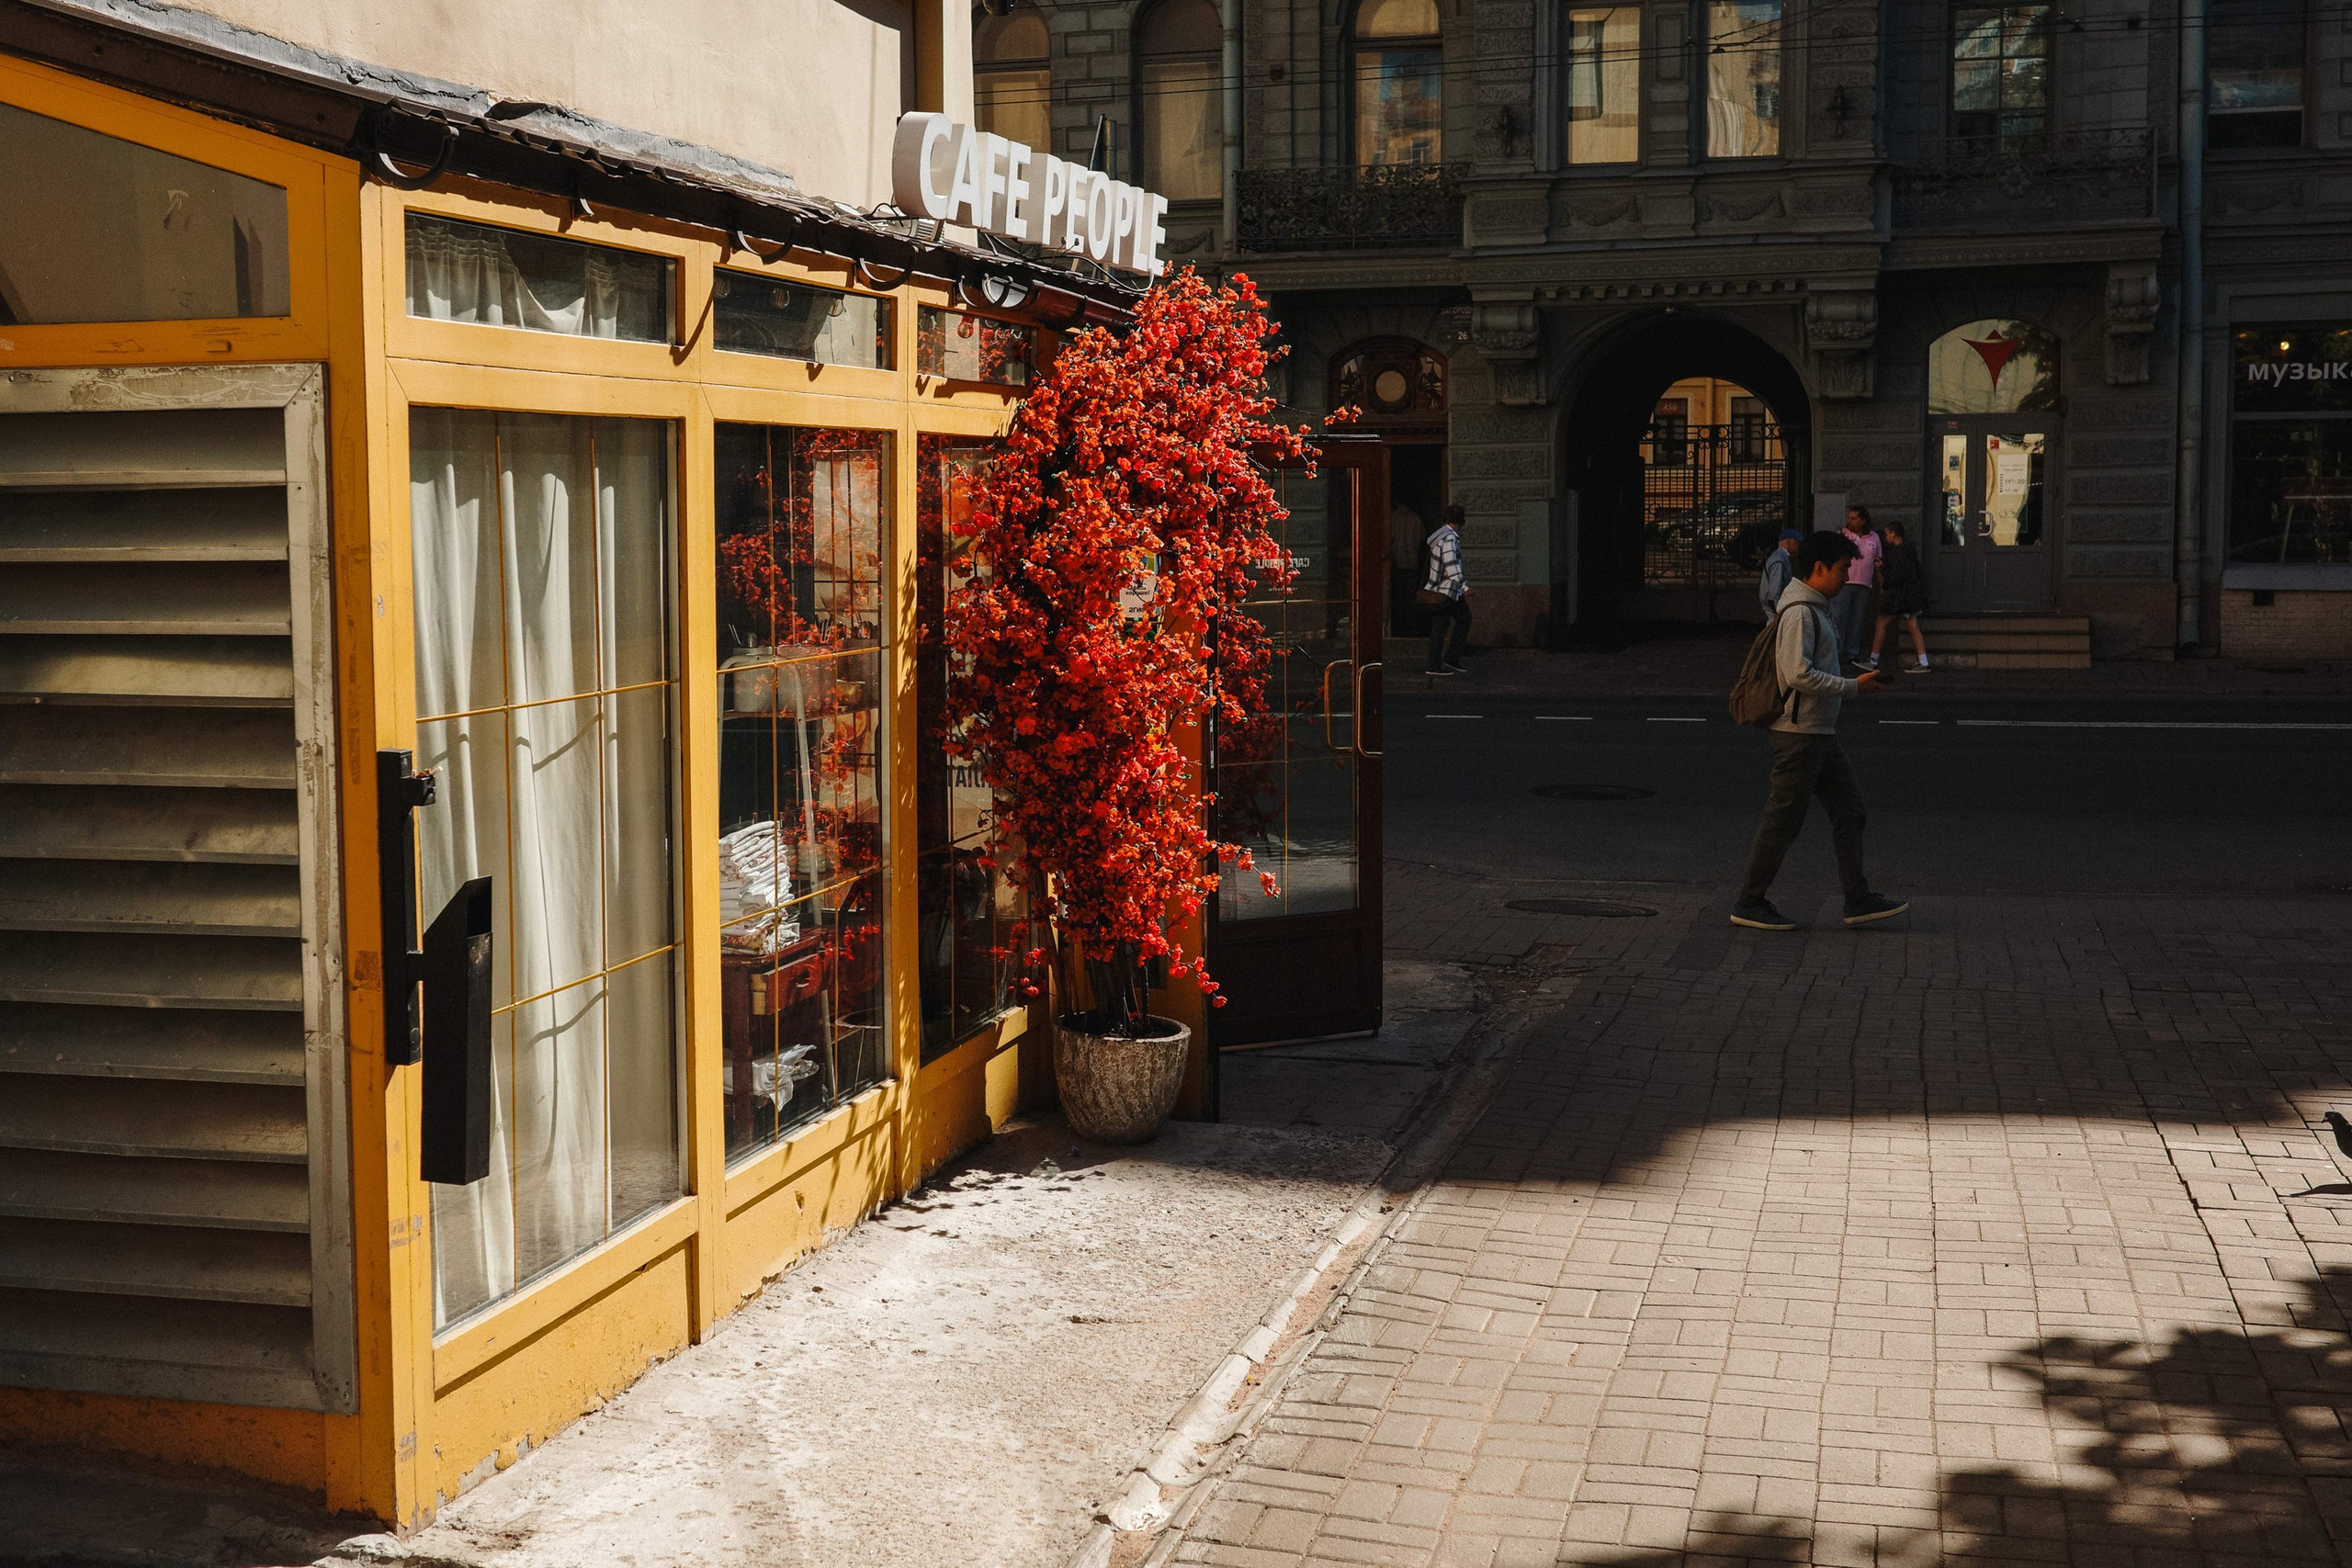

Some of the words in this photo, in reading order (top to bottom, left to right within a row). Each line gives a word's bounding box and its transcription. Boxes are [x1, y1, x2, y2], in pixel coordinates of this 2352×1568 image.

[920, 112, 1032, 238] CAFE
[1042, 153, 1168, 276] PEOPLE
[1441, 306, 1472, 314] ЗАГОРОД
[1458, 331, 1468, 340] 26
[2248, 362, 2352, 388] музык
